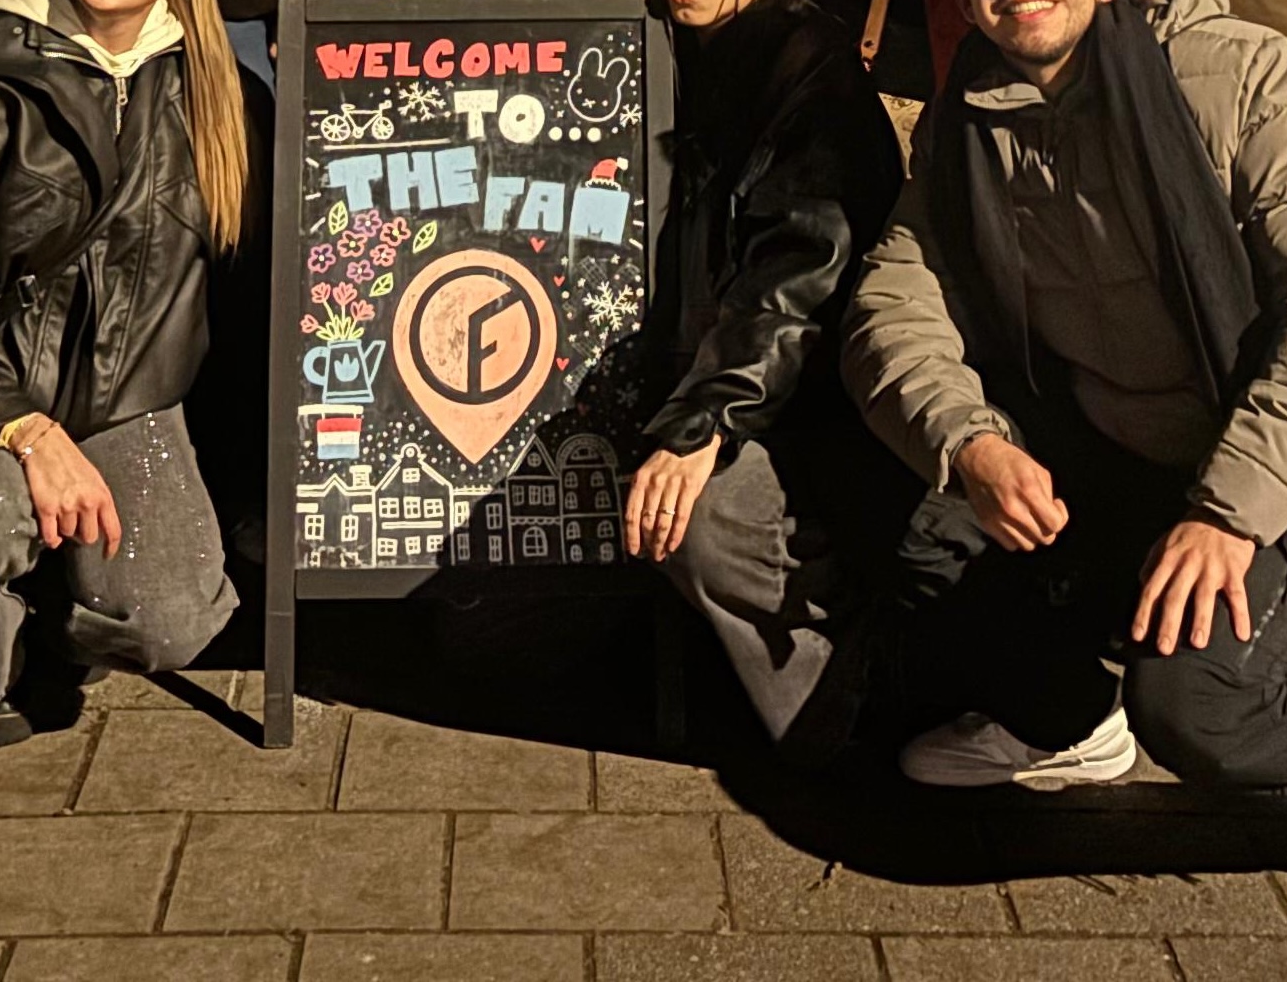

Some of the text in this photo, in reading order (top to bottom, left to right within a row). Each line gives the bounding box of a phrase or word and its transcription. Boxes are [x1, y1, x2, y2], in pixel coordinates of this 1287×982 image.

[315, 38, 567, 80] WELCOME
[327, 145, 631, 246] THE FAM
